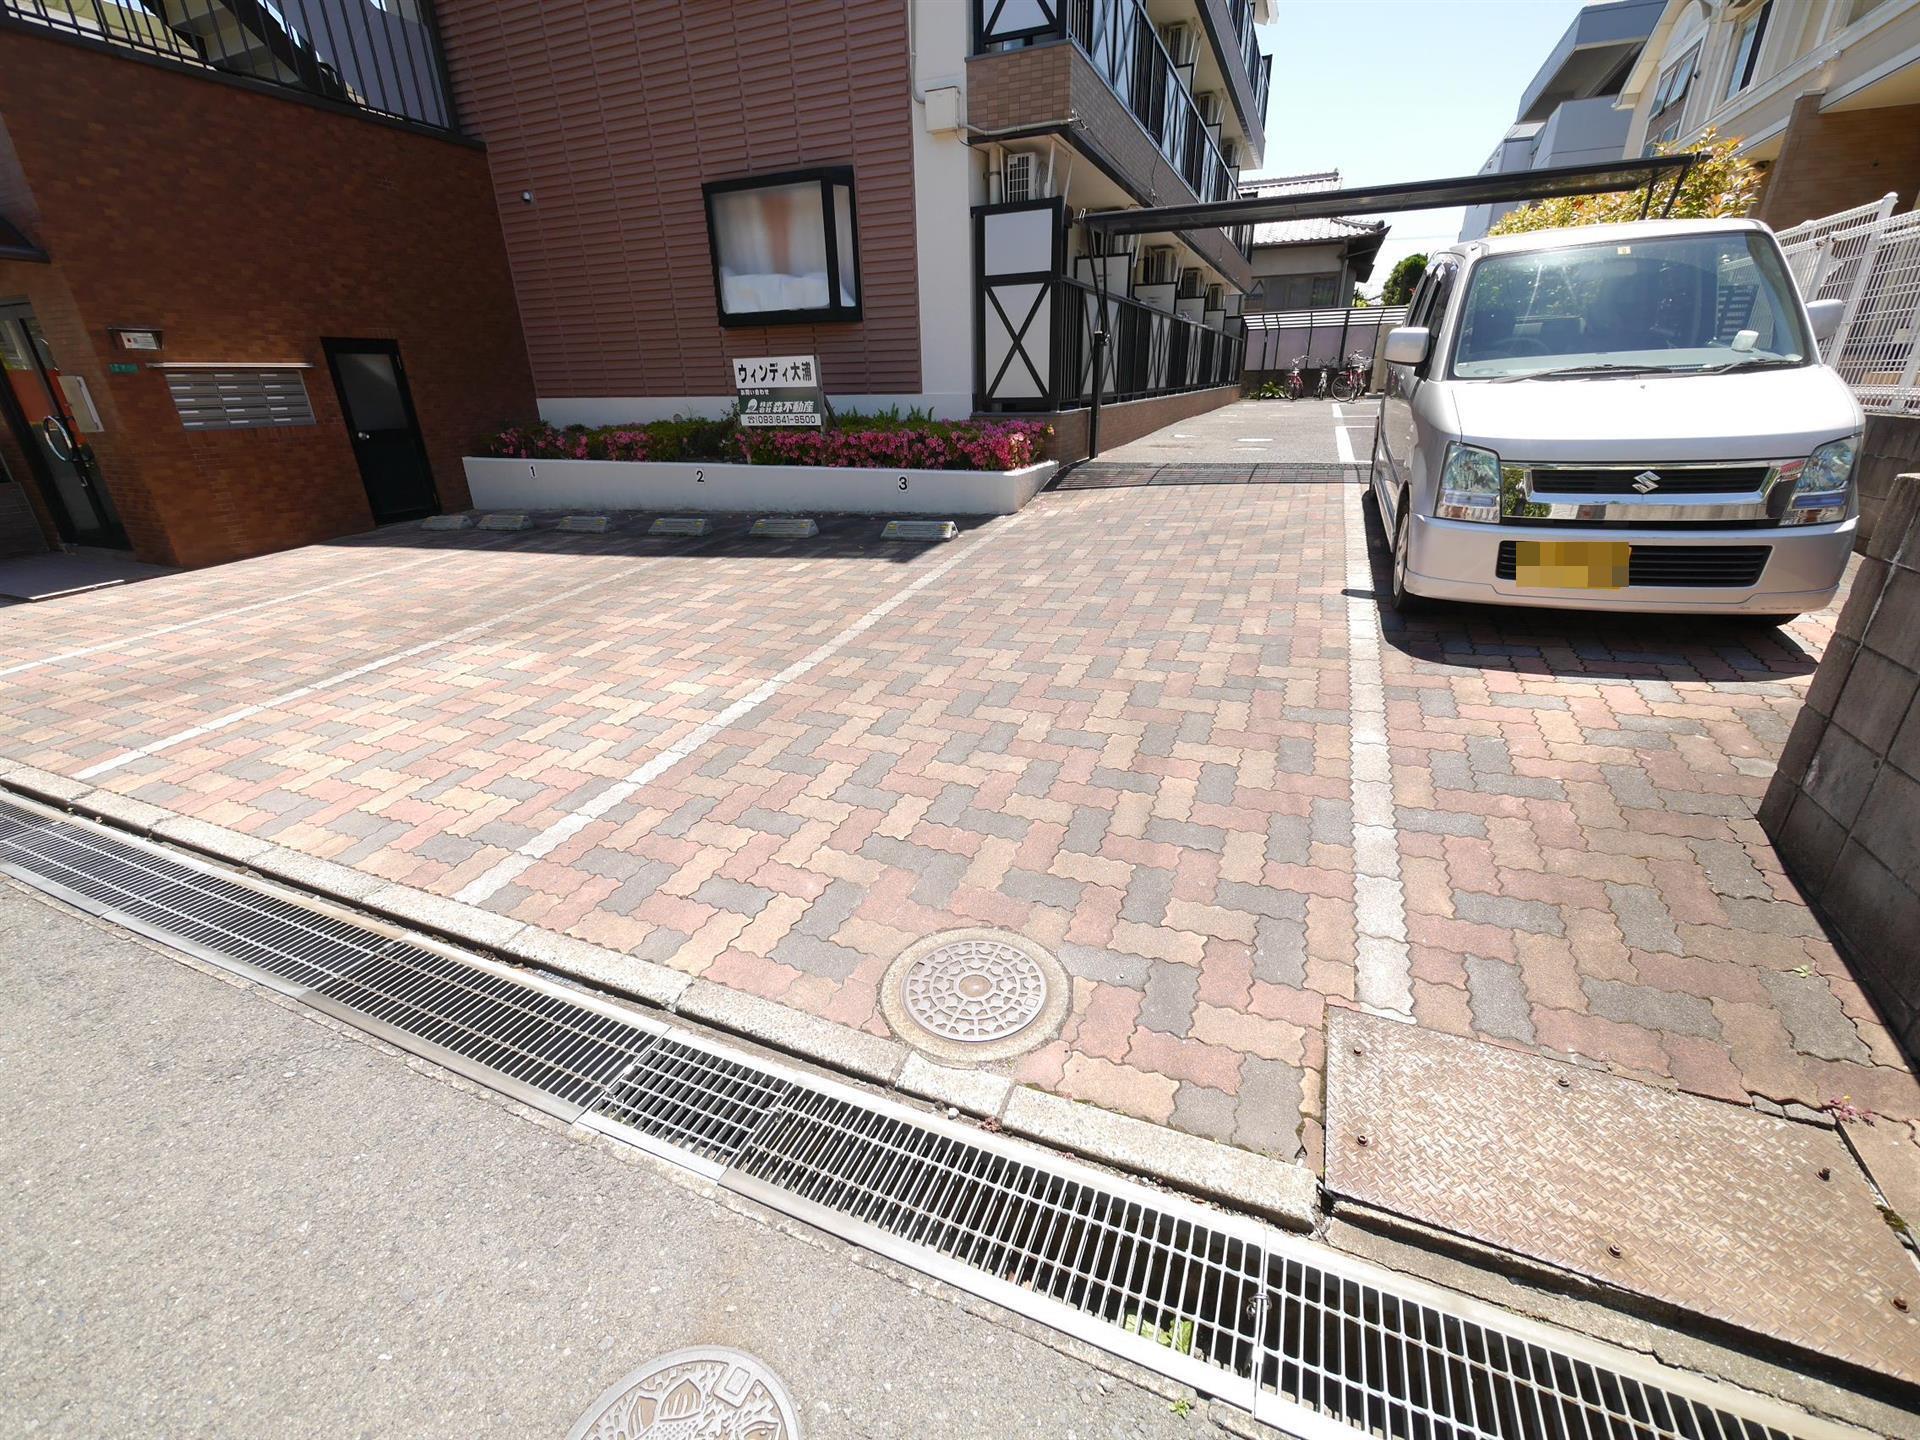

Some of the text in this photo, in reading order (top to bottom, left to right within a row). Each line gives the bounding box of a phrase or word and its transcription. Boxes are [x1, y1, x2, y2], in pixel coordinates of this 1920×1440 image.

[738, 361, 812, 383] ウィンディ大浦
[696, 470, 705, 483] 2
[898, 476, 908, 491] 3
